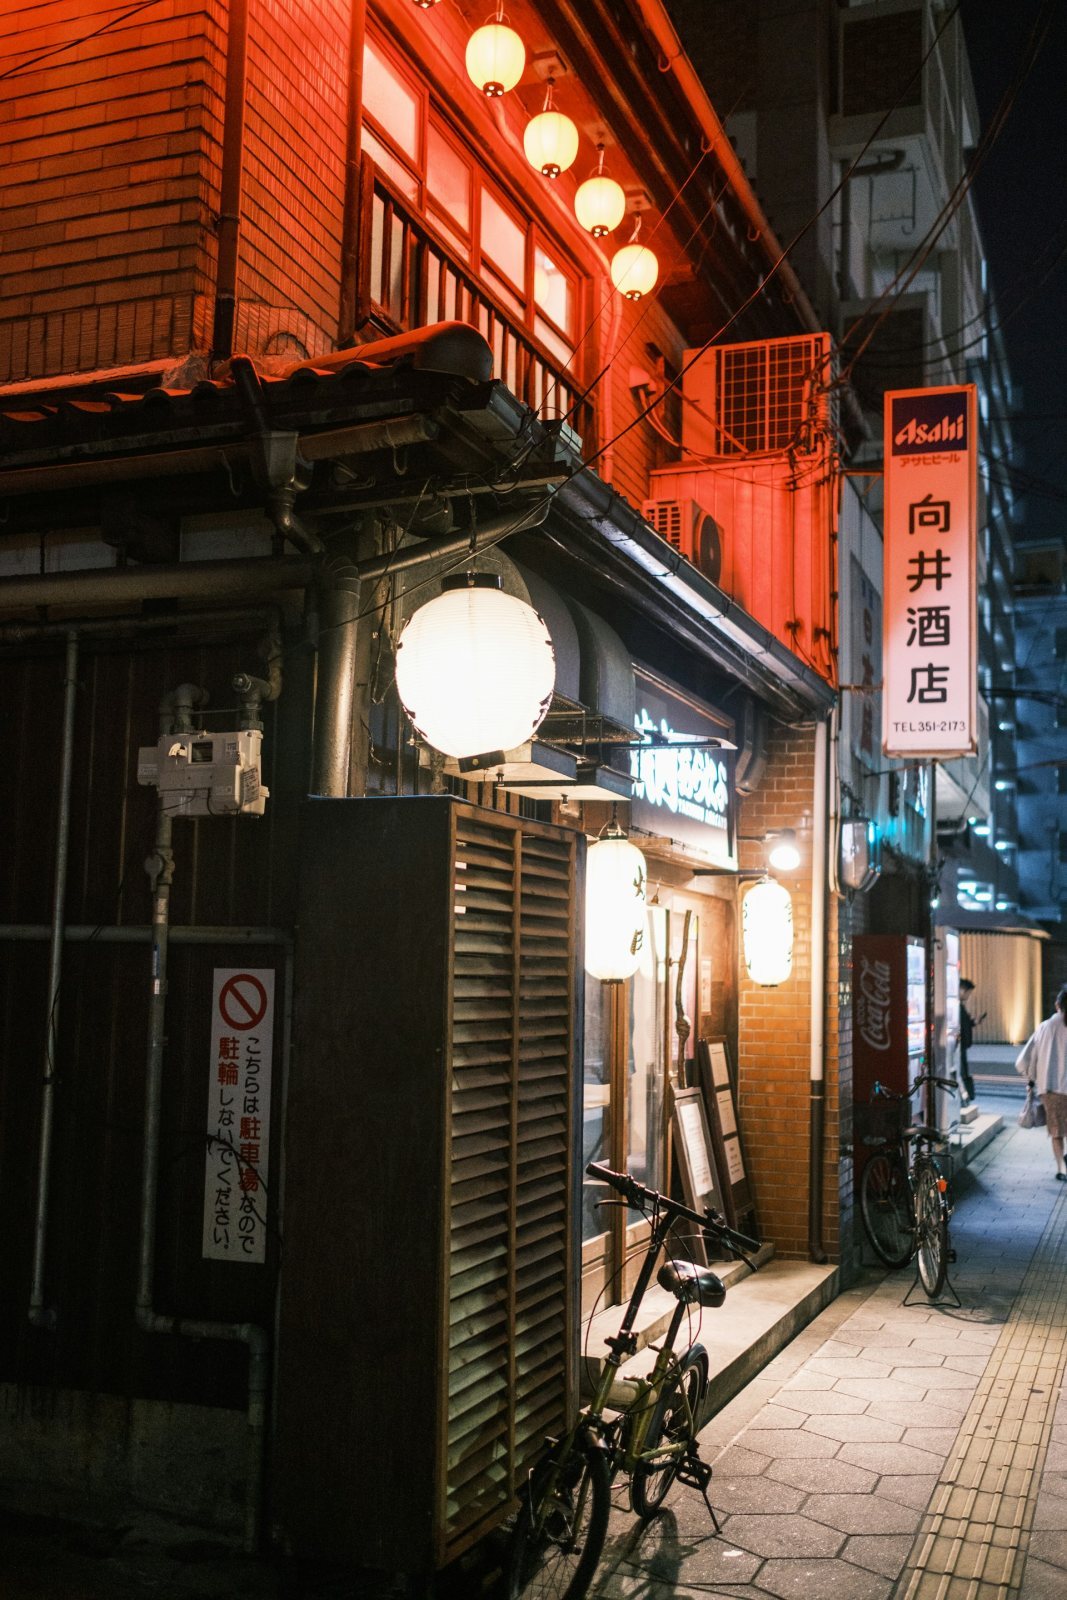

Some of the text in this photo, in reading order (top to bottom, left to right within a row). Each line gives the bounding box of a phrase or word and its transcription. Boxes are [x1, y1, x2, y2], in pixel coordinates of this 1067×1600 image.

[894, 414, 964, 446] Asahi
[900, 453, 960, 468] アサヒビール
[907, 493, 952, 703] 向井酒店
[239, 1036, 262, 1254] こちらは駐車場なので
